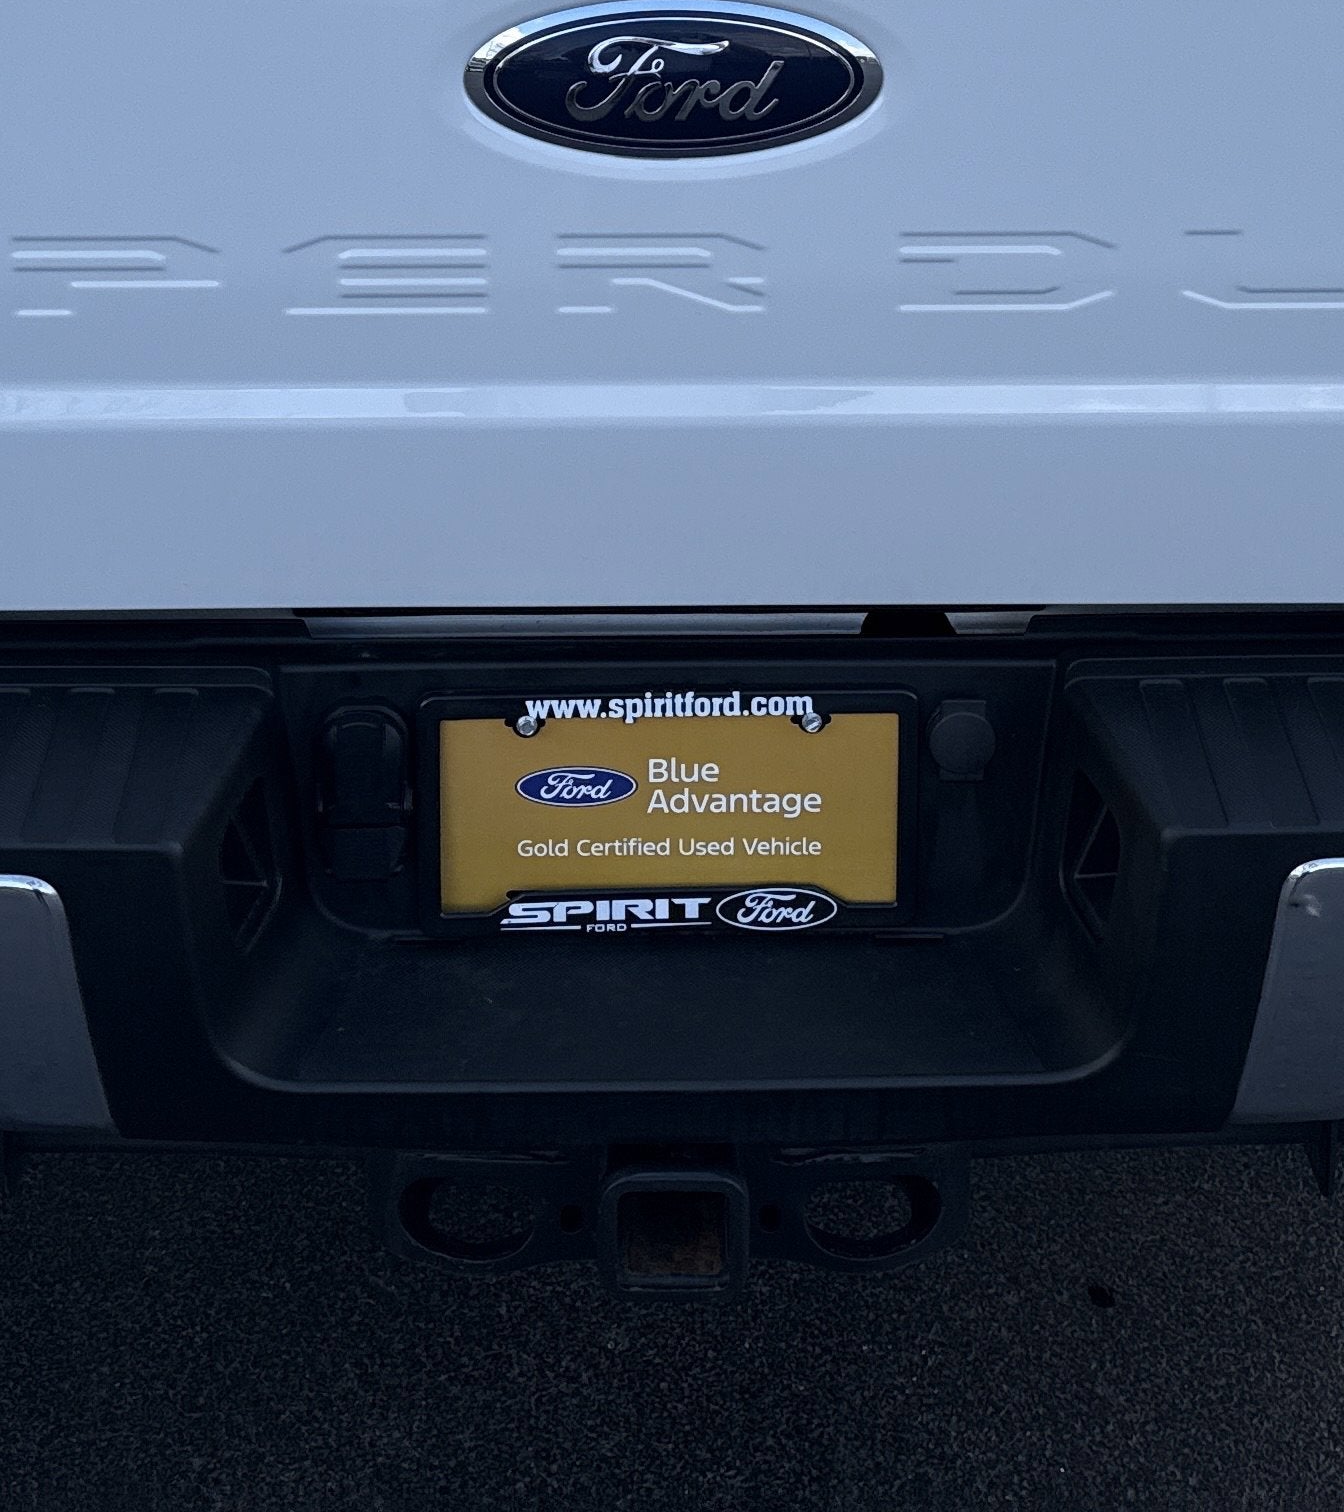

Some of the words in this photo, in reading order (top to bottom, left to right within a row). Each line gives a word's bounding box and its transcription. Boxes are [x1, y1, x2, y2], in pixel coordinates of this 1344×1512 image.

[564, 36, 785, 121] Ford
[525, 691, 813, 724] www.spiritford.com
[648, 757, 720, 783] Blue
[540, 772, 612, 800] Ford
[647, 789, 822, 818] Advantage
[517, 839, 569, 857] Gold
[576, 838, 671, 857] Certified
[678, 838, 734, 856] Used
[742, 837, 822, 856] Vehicle
[500, 897, 712, 924] SPIRIT
[736, 892, 816, 924] Ford
[586, 924, 627, 933] FORD
